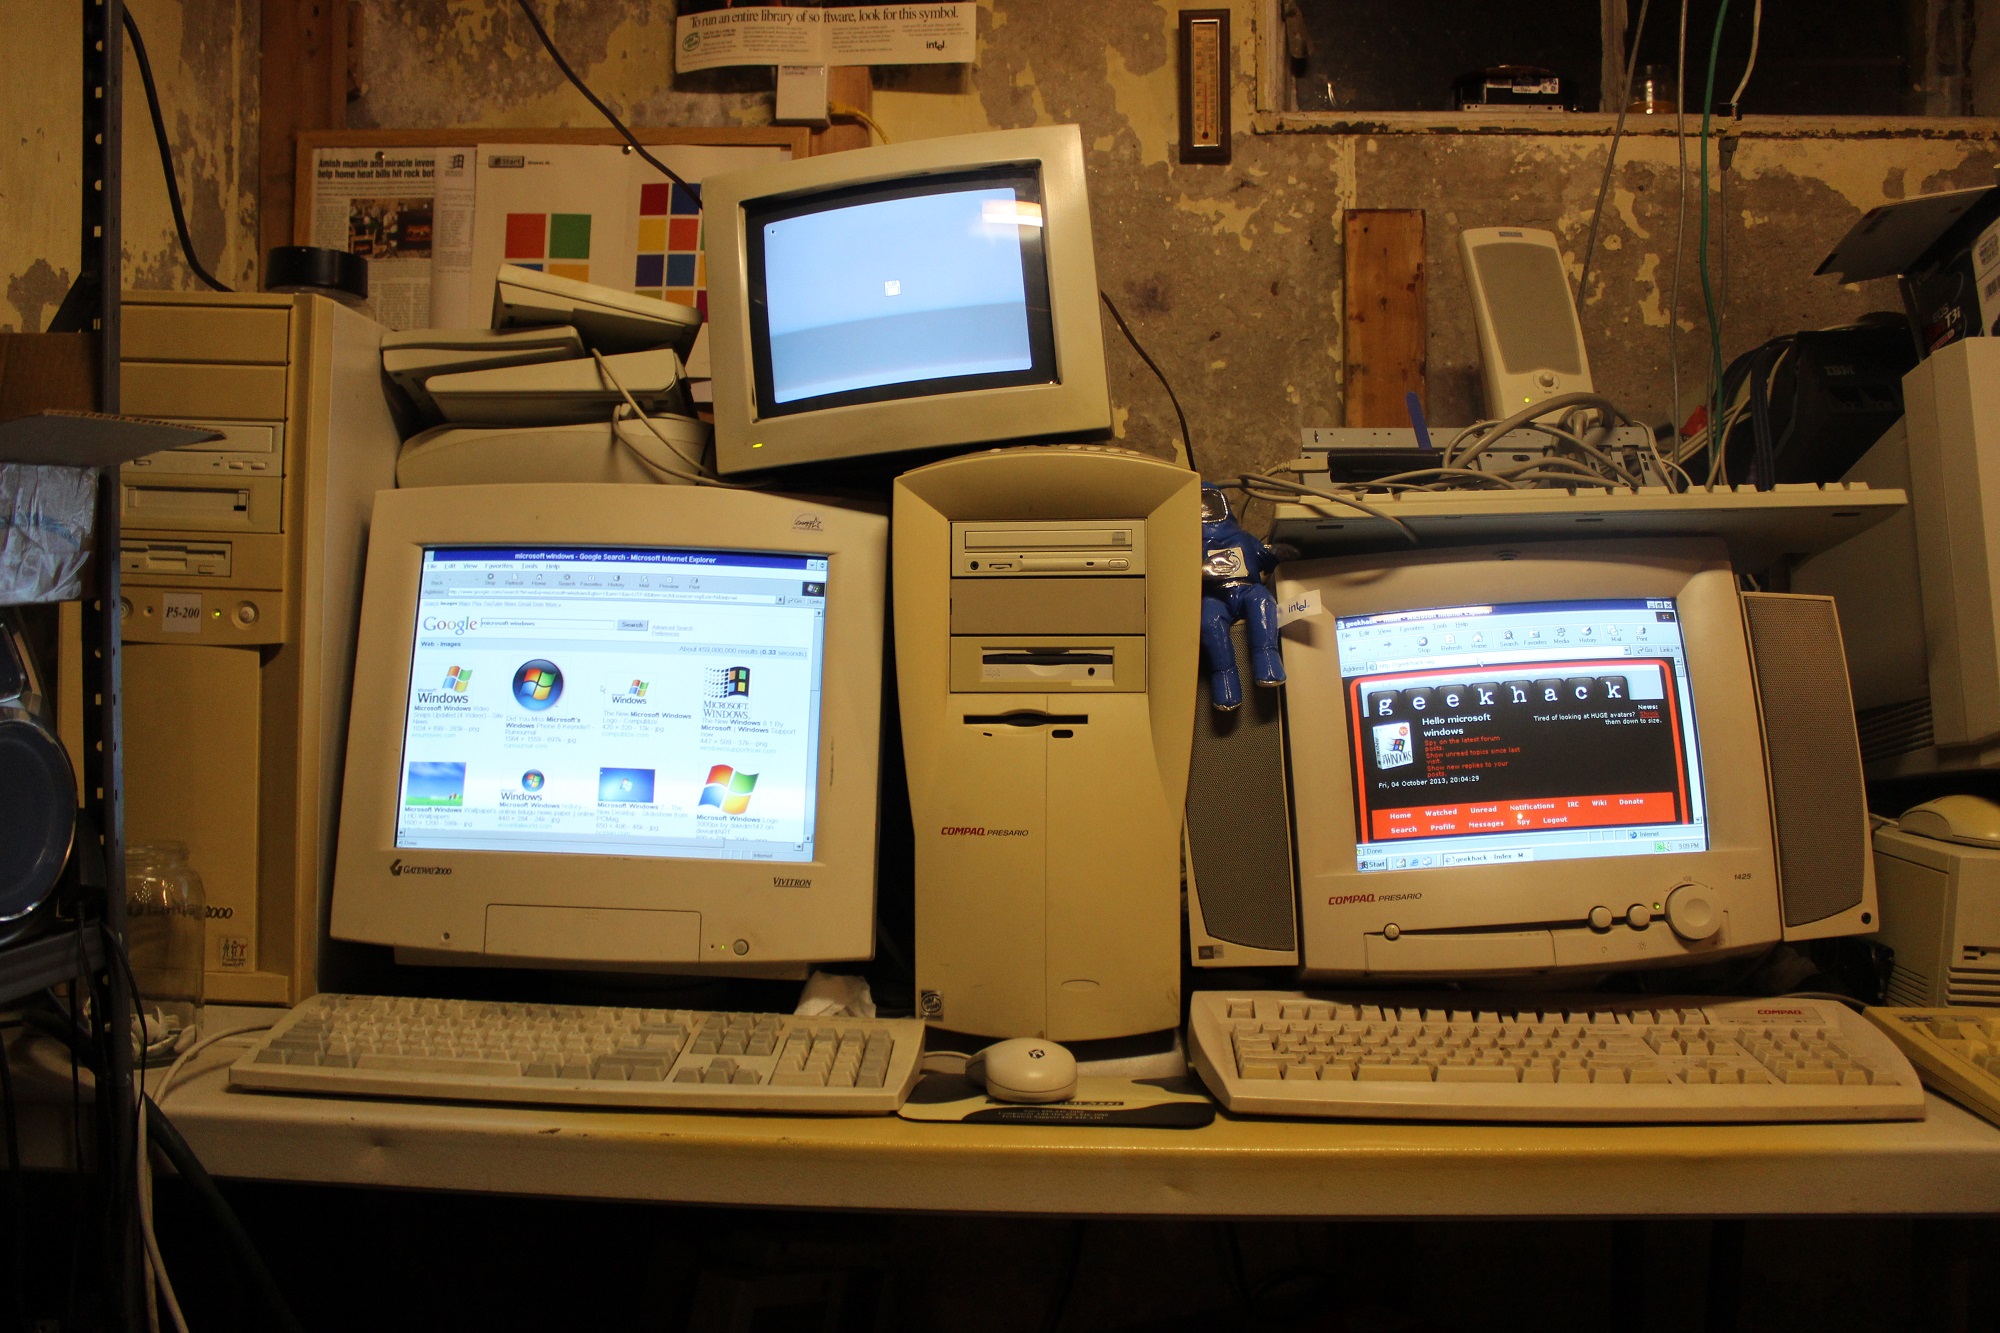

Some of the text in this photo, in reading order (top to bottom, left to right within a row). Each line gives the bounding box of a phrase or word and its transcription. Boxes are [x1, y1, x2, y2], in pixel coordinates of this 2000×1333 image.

[691, 17, 700, 28] To
[702, 17, 717, 26] run
[719, 14, 730, 23] an
[732, 10, 758, 23] entire
[761, 10, 793, 25] library
[796, 11, 806, 22] of
[860, 9, 880, 20] look
[883, 8, 897, 20] for
[900, 8, 916, 19] this
[919, 6, 958, 22] symbol.
[927, 41, 945, 50] intel
[320, 160, 340, 168] Amish
[318, 170, 332, 179] help
[580, 553, 601, 561] Google
[689, 556, 716, 564] Explorer
[1288, 600, 1307, 613] intel
[166, 607, 199, 618] P5-200
[423, 616, 477, 635] Google
[418, 693, 468, 703] Windows
[612, 696, 647, 704] Windows
[1422, 713, 1491, 726] Hello microsoft
[1424, 728, 1463, 737] windows
[1470, 749, 1488, 757] topics
[1402, 779, 1427, 787] October
[501, 792, 542, 801] Windows
[1425, 809, 1457, 817] Watched
[1470, 806, 1497, 814] Unread
[1510, 803, 1555, 811] Notifications
[941, 827, 985, 836] COMPAQ
[1391, 826, 1417, 834] Search
[1456, 855, 1487, 863] geekhack
[774, 877, 811, 886] VIVITRON
[1328, 893, 1422, 905] COMPAQ PRESARIO
